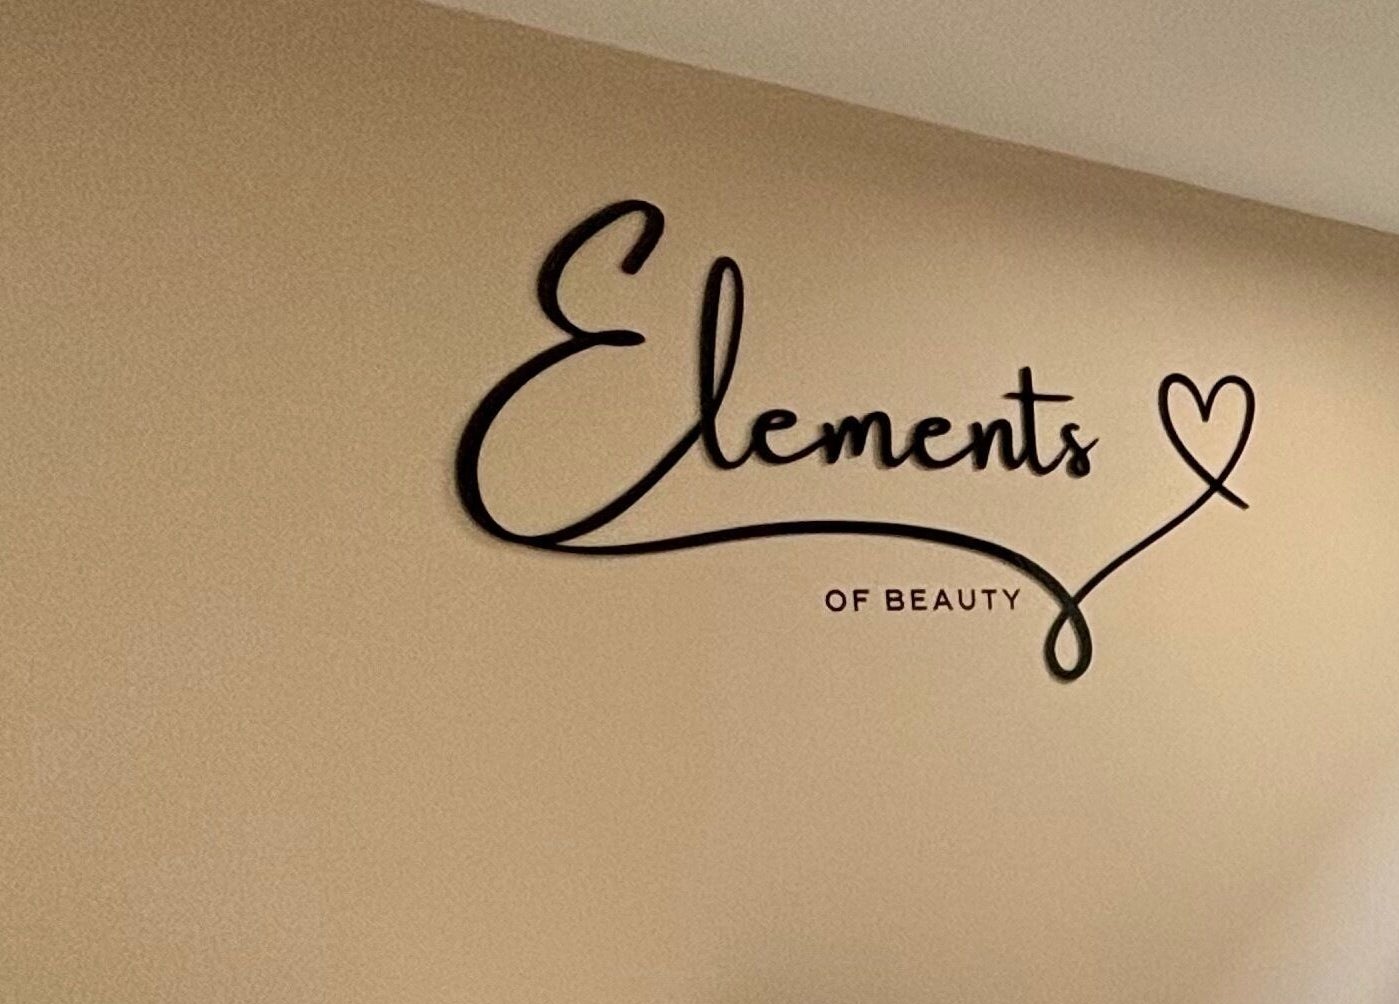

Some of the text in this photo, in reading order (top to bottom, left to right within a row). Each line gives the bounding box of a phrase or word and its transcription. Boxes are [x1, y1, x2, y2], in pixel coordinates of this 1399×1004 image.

[456, 200, 1100, 553] Elements
[825, 588, 1020, 612] OF BEAUTY
